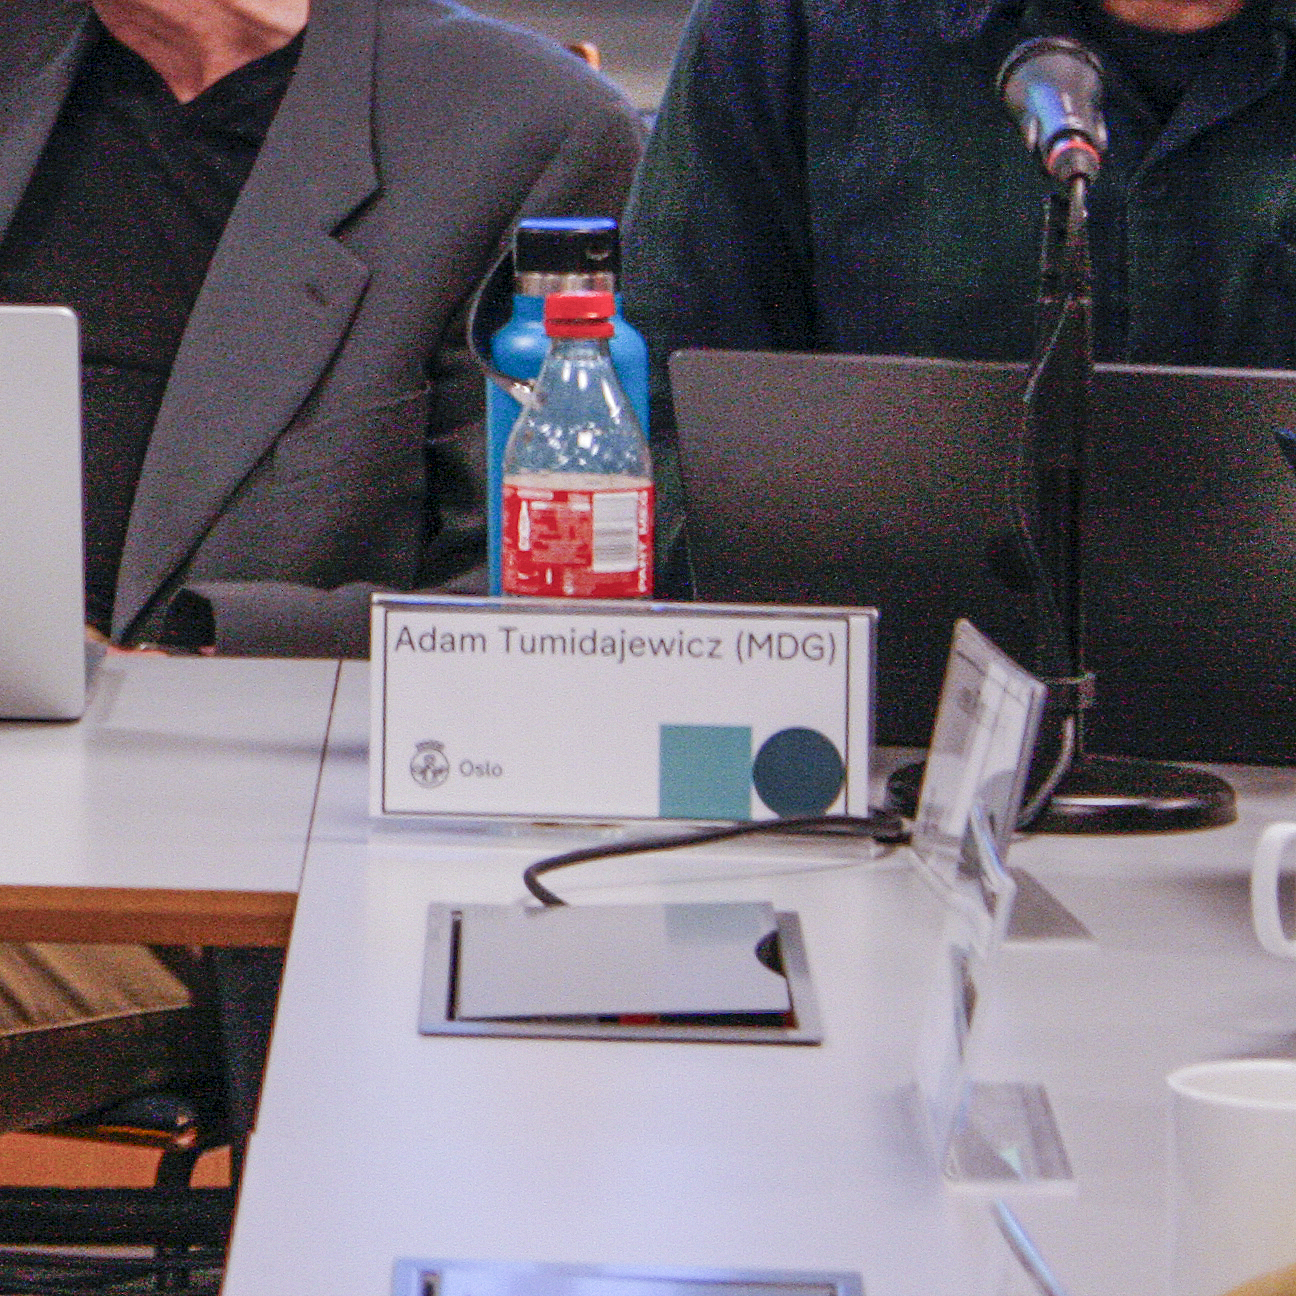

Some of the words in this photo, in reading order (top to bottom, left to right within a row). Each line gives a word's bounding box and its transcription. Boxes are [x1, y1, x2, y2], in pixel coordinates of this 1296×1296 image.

[394, 626, 487, 654] Adam
[501, 627, 723, 664] Tumidajewicz
[736, 630, 837, 666] (MDG)
[459, 758, 503, 778] Oslo
